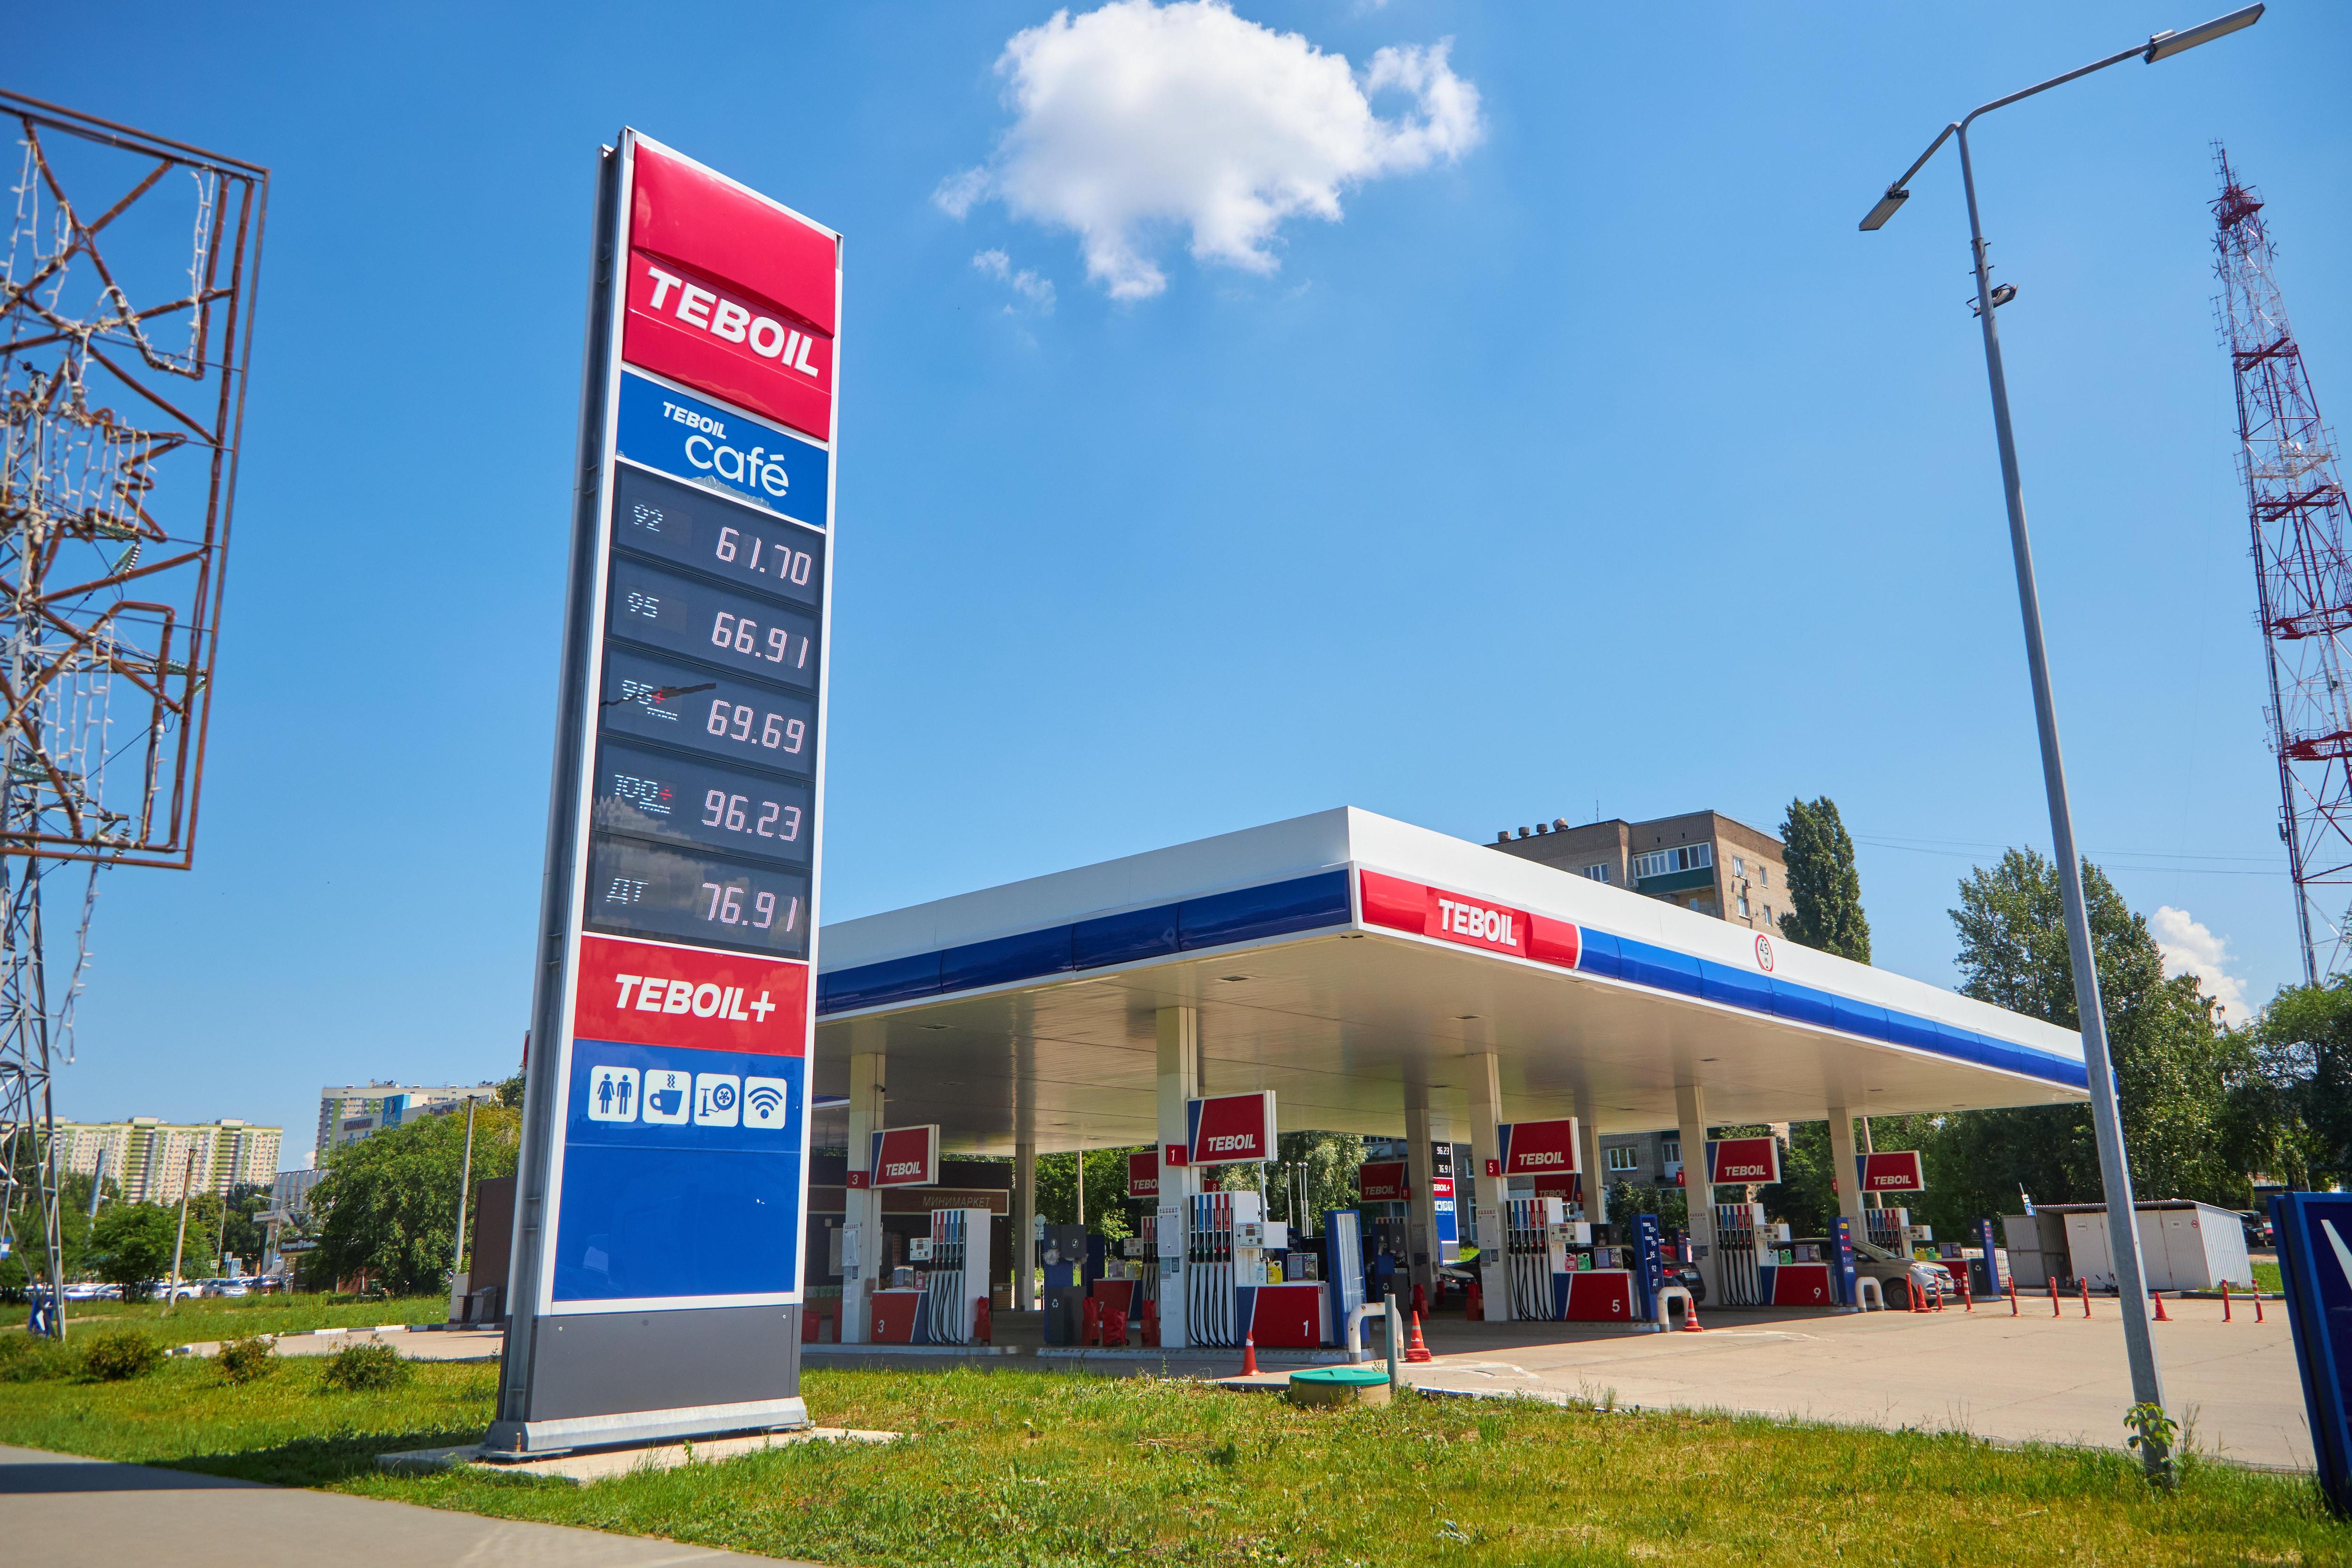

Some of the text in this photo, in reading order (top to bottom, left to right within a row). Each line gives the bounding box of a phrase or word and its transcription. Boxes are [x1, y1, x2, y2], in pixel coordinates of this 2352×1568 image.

[647, 266, 819, 378] TEBOIL
[662, 401, 727, 439] TEBOIL
[684, 435, 789, 496] café
[634, 504, 812, 587] 92 61.70
[628, 592, 809, 669] 95 66.91
[707, 699, 806, 754] 69.69
[701, 789, 801, 842] 96.23
[702, 882, 798, 932] 76.91
[1438, 898, 1517, 947] TEBOIL
[614, 973, 776, 1023] TEBOIL+
[1208, 1133, 1256, 1152] TEBOIL
[1171, 1149, 1175, 1162] 1
[1437, 1146, 1450, 1155] 96.23
[1519, 1152, 1565, 1165] TEBOIL
[886, 1162, 921, 1176] TEBOIL
[1438, 1164, 1451, 1173] 76.91
[1489, 1162, 1494, 1173] 5
[1724, 1165, 1766, 1176] TEBOIL
[852, 1174, 858, 1185] 3
[1133, 1178, 1159, 1190] TEBO
[1678, 1174, 1683, 1183] 9
[1874, 1175, 1911, 1185] TEBOIL
[1213, 1183, 1216, 1192] 8
[1365, 1186, 1396, 1195] TEBOIL
[1539, 1189, 1568, 1198] TEBOIL
[922, 1195, 991, 1208] МИНИМАРКЕТ
[1653, 1279, 1658, 1287] ДТ
[1813, 1288, 1821, 1298] 9
[1099, 1302, 1104, 1312] 7
[1612, 1299, 1620, 1313] 5
[878, 1320, 884, 1333] 3
[1303, 1320, 1309, 1337] 1
